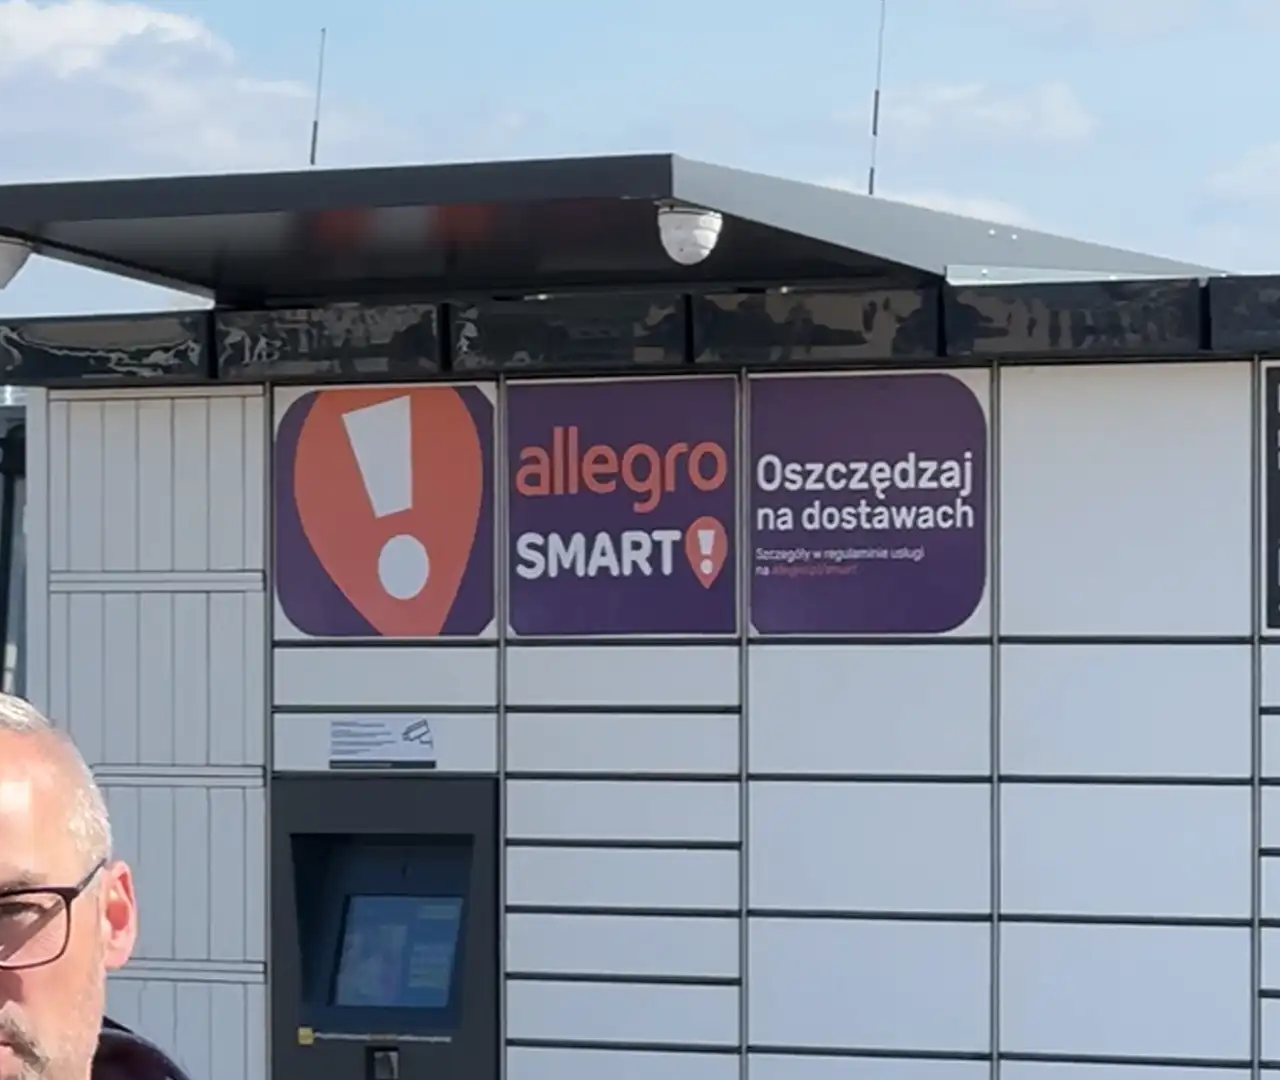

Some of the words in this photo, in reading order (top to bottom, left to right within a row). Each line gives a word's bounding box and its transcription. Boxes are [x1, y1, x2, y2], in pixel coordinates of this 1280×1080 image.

[516, 426, 728, 513] allegro
[757, 452, 973, 499] Oszczędzaj
[757, 507, 793, 531] na
[801, 498, 974, 530] dostawach
